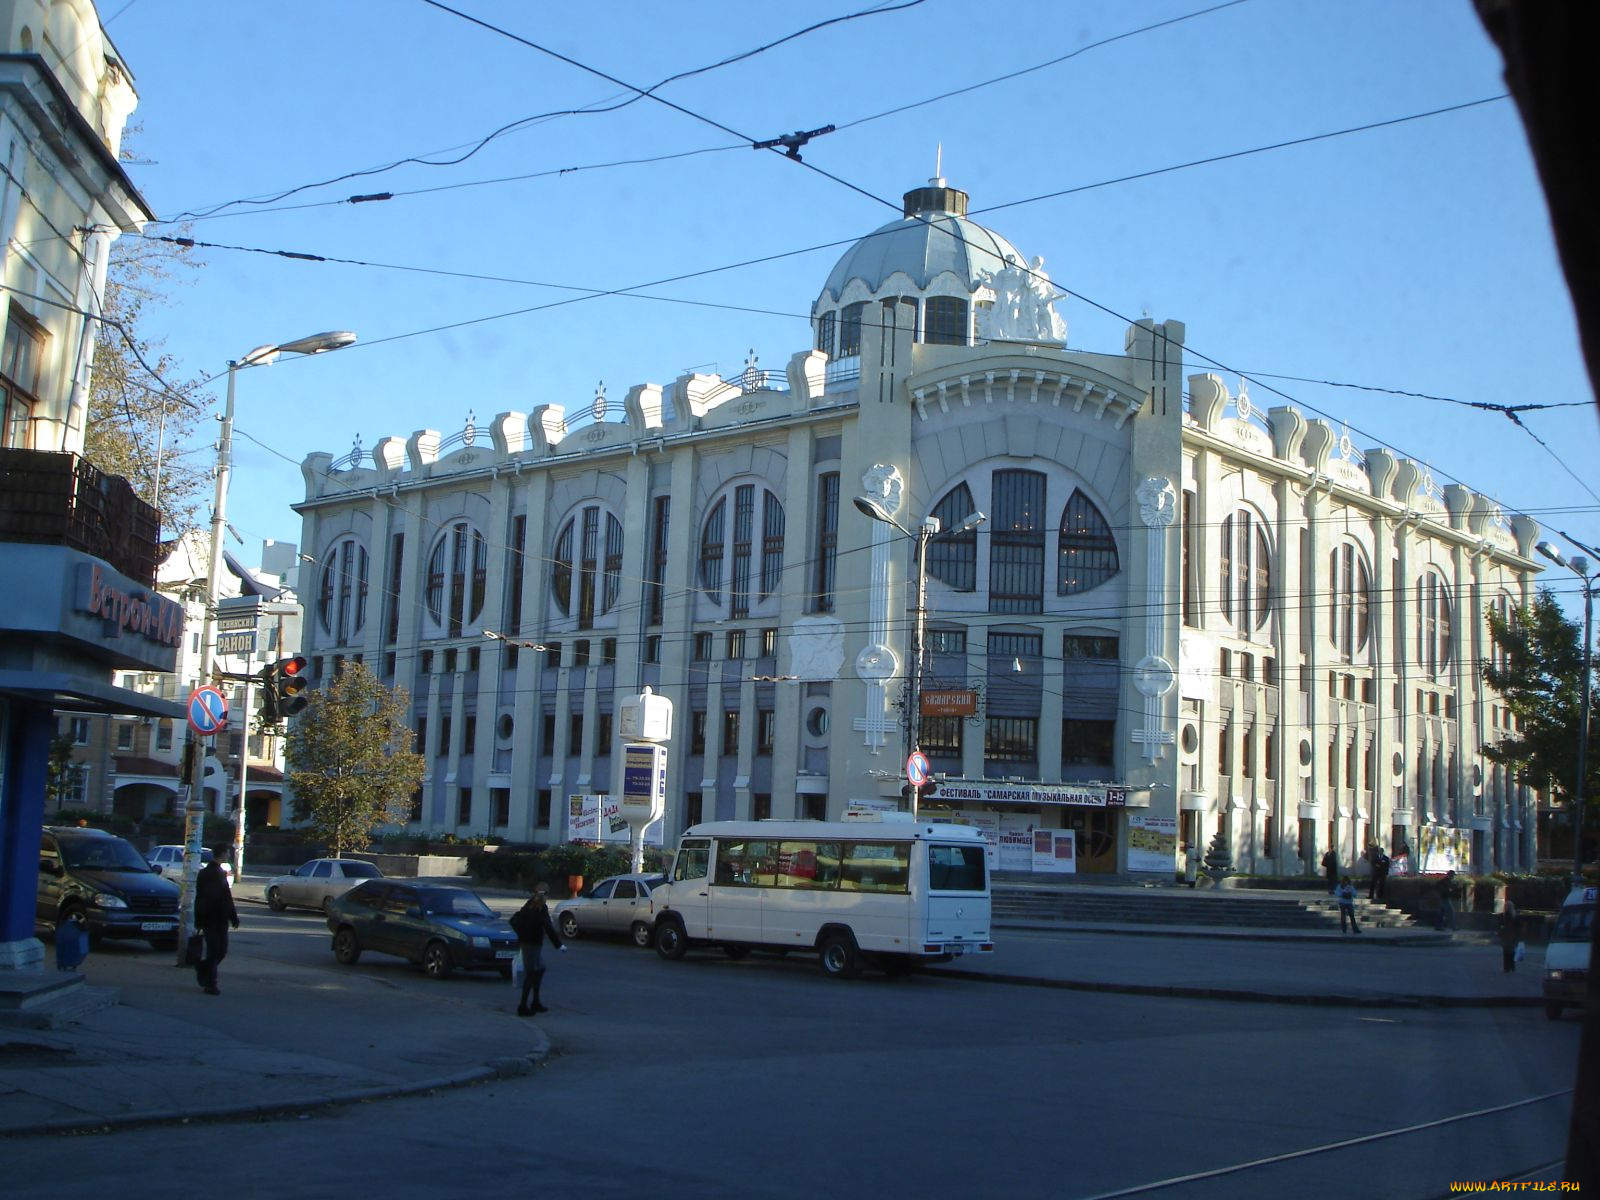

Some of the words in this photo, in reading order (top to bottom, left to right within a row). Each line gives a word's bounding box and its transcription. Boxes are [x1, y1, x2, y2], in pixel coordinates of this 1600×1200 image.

[217, 633, 252, 652] РАЙОН
[940, 787, 982, 799] ФЕСТИВАЛЬ
[1032, 791, 1083, 804] МУЗЫКАЛЬНАЯ
[1108, 791, 1125, 802] 1-15
